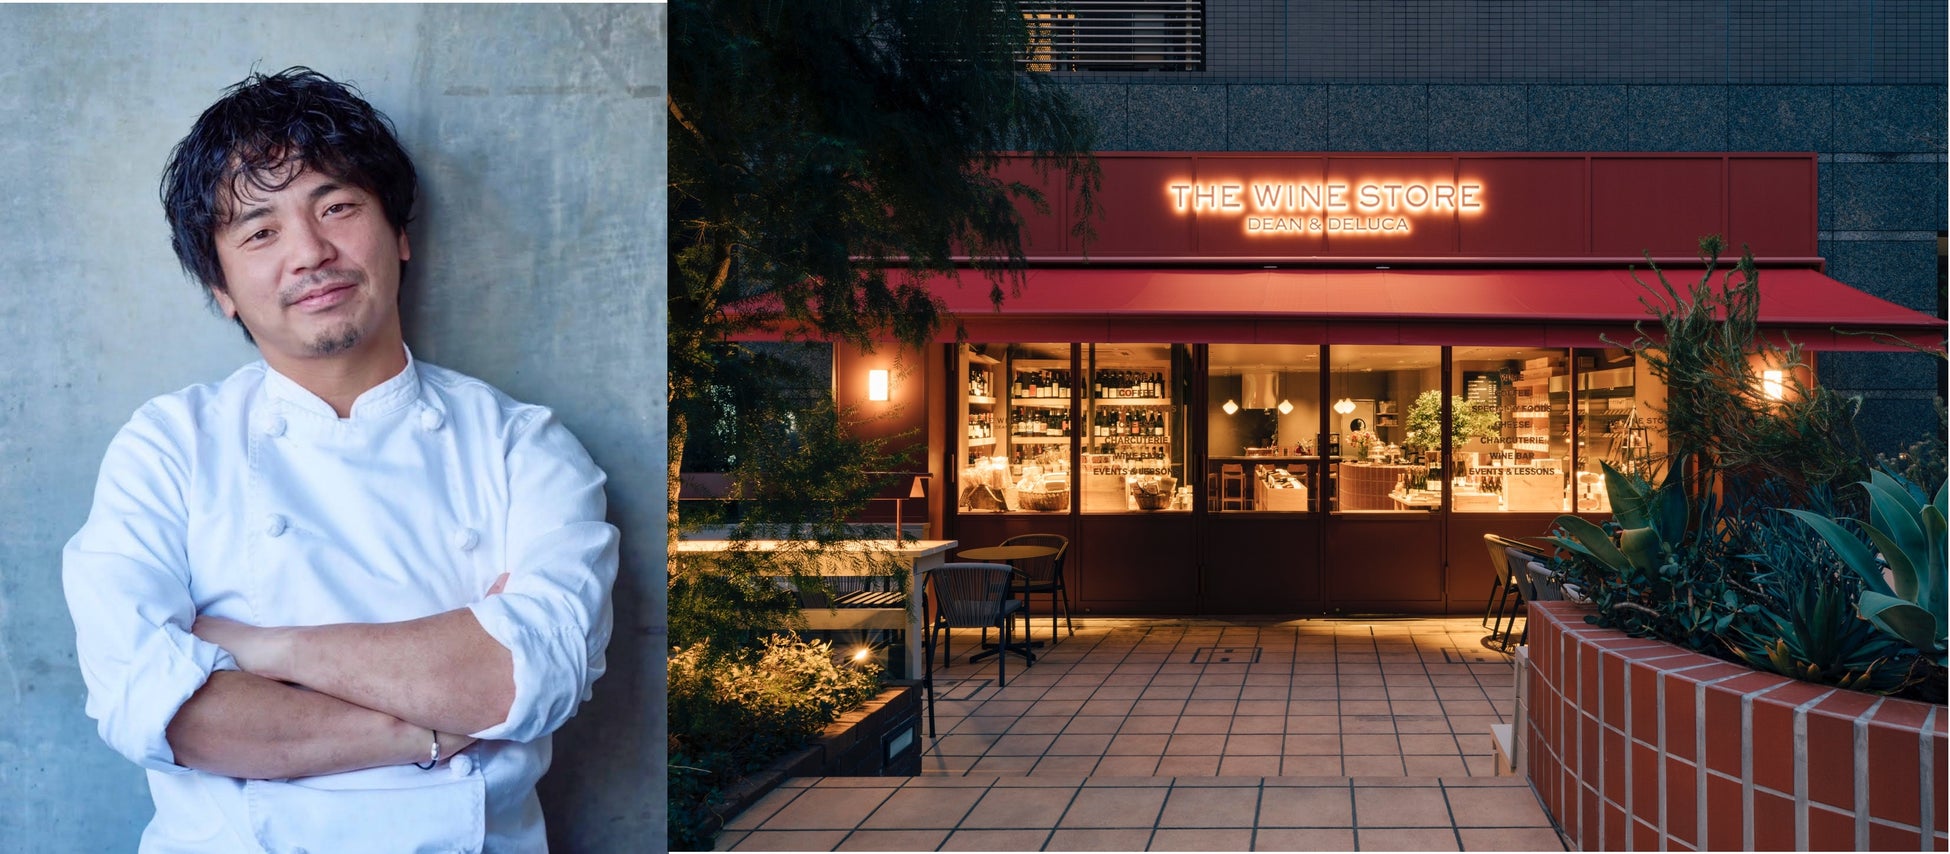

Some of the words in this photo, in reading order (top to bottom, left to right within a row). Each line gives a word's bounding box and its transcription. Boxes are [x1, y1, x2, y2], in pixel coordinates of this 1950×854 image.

[1171, 185, 1241, 207] THE
[1254, 185, 1347, 207] WINE
[1360, 185, 1480, 207] STORE
[1248, 217, 1302, 231] DEAN
[1309, 217, 1322, 231] &
[1328, 217, 1409, 231] DELUCA
[1118, 389, 1155, 397] COFFEE
[1521, 405, 1552, 413] FOODS
[1494, 421, 1530, 429] CHEESE
[1104, 436, 1168, 444] CHARCUTERIE
[1480, 436, 1545, 444] CHARCUTERIE
[1114, 452, 1139, 460] WINE
[1489, 452, 1513, 460] WINE
[1515, 452, 1535, 460] BAR
[1093, 467, 1128, 475] EVENTS
[1468, 467, 1503, 475] EVENTS
[1505, 467, 1513, 475] &
[1514, 467, 1555, 475] LESSONS
